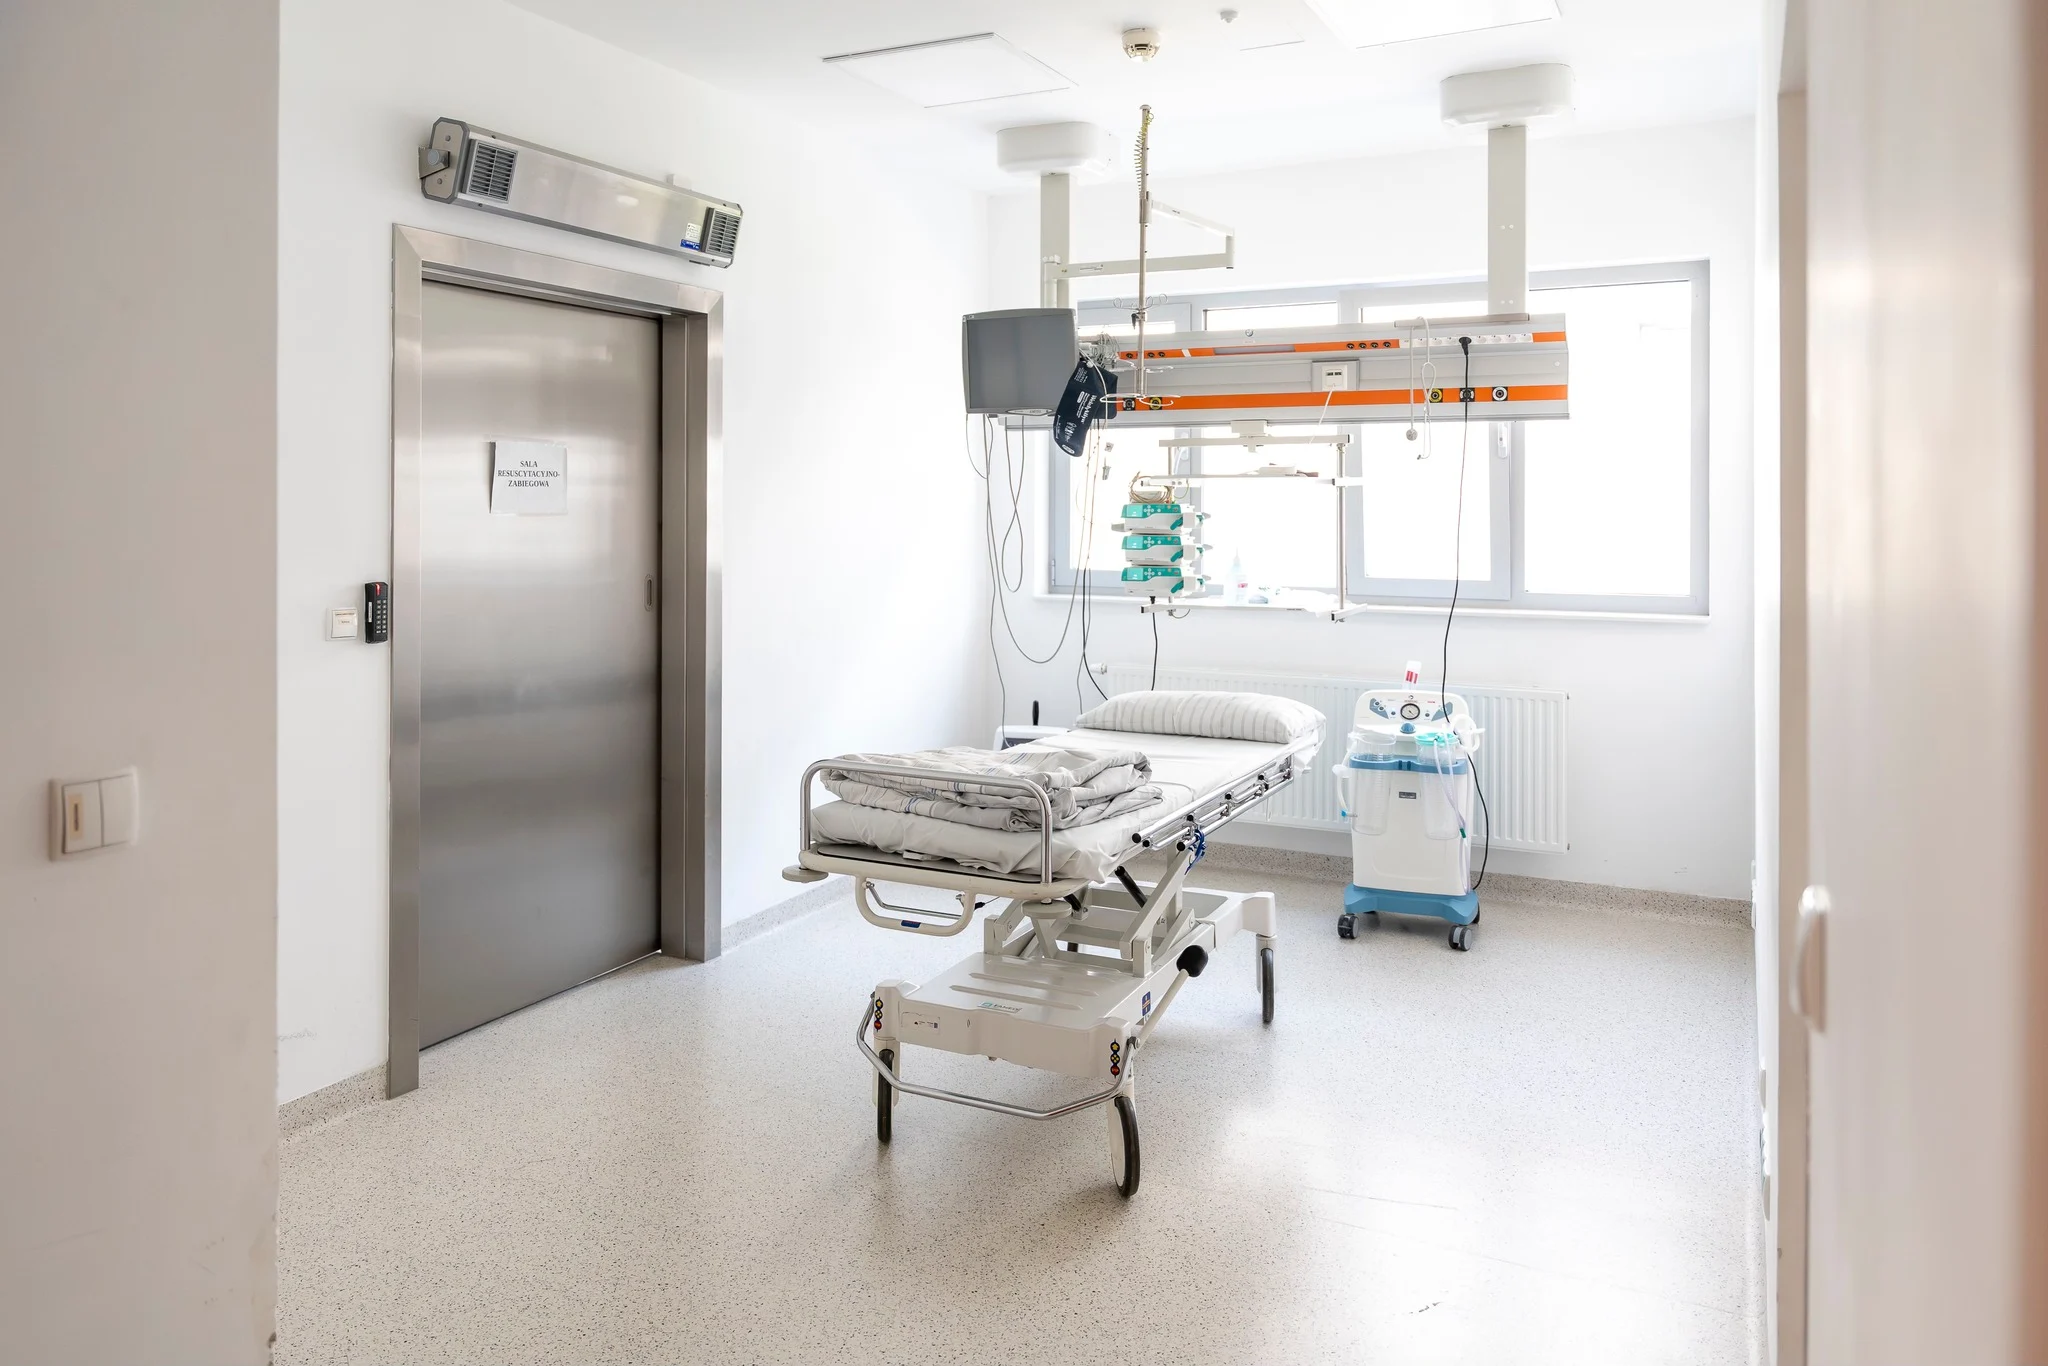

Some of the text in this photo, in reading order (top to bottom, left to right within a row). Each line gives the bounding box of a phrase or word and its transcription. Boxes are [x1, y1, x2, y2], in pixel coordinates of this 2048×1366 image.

[520, 460, 538, 468] SALA
[497, 469, 561, 478] RESUSCYTACYJNO-
[508, 480, 550, 488] ZABIEGOWA
